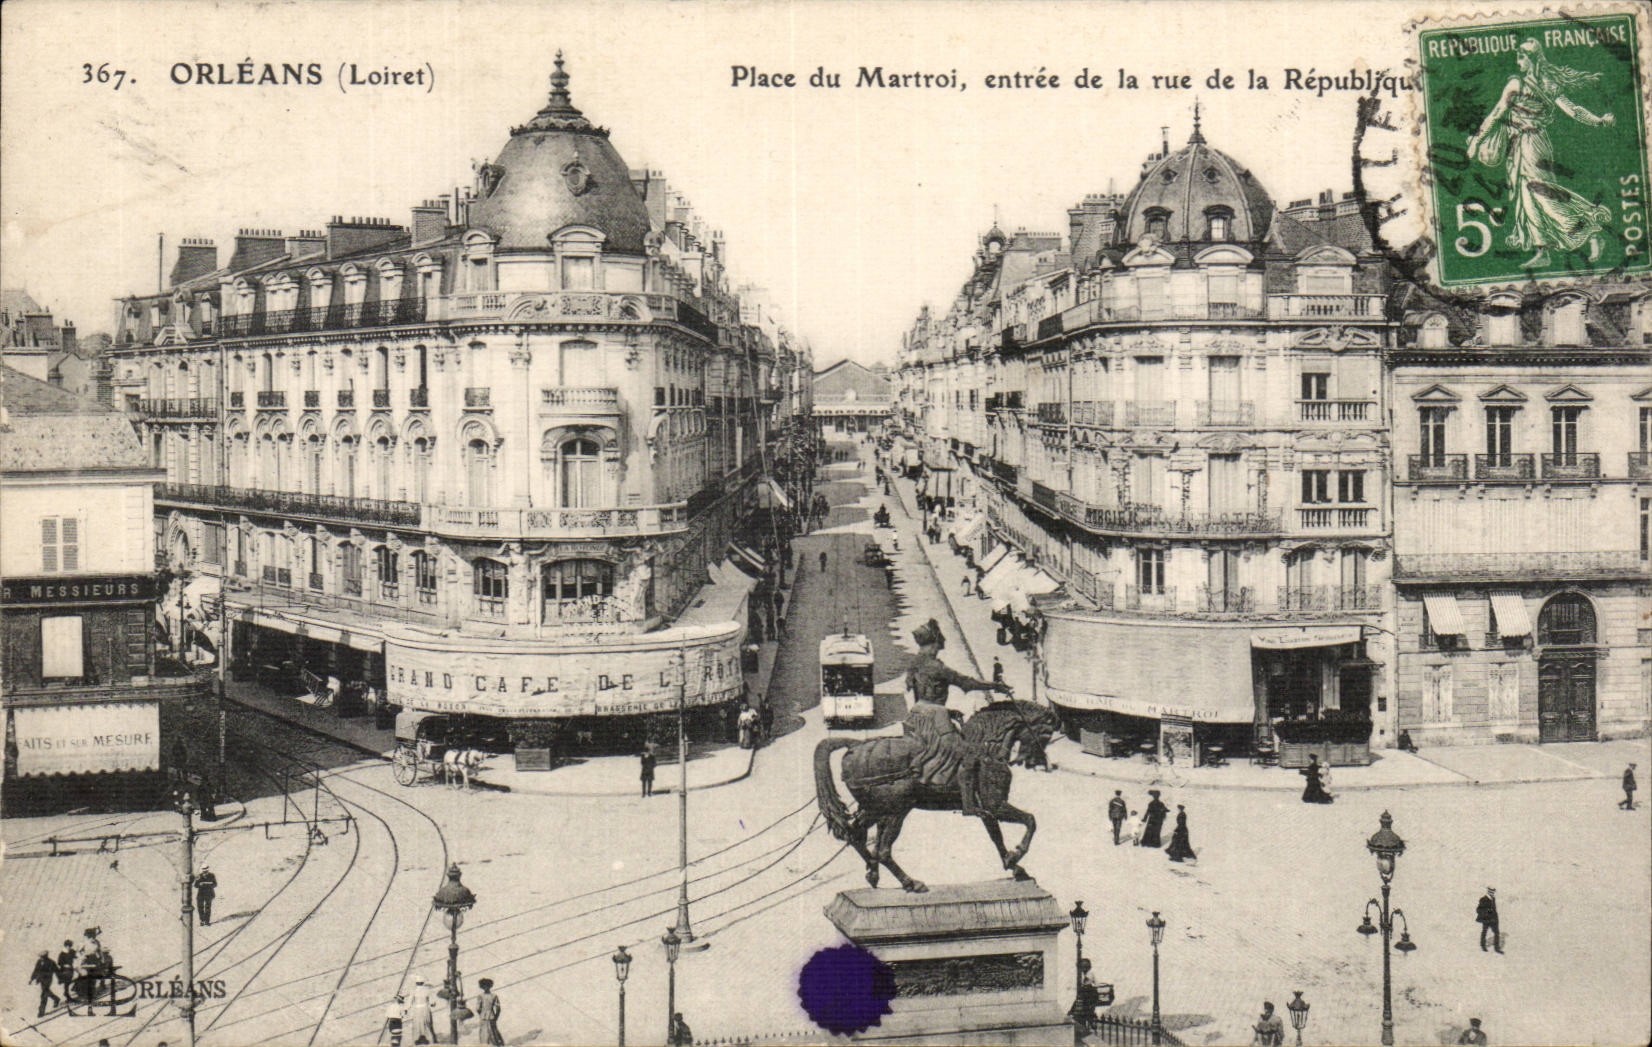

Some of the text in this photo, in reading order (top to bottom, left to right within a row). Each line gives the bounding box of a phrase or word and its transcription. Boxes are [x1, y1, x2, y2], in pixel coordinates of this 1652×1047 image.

[1620, 174, 1645, 256] POSTES
[30, 583, 139, 598] MESSIEURS
[599, 674, 632, 691] DE
